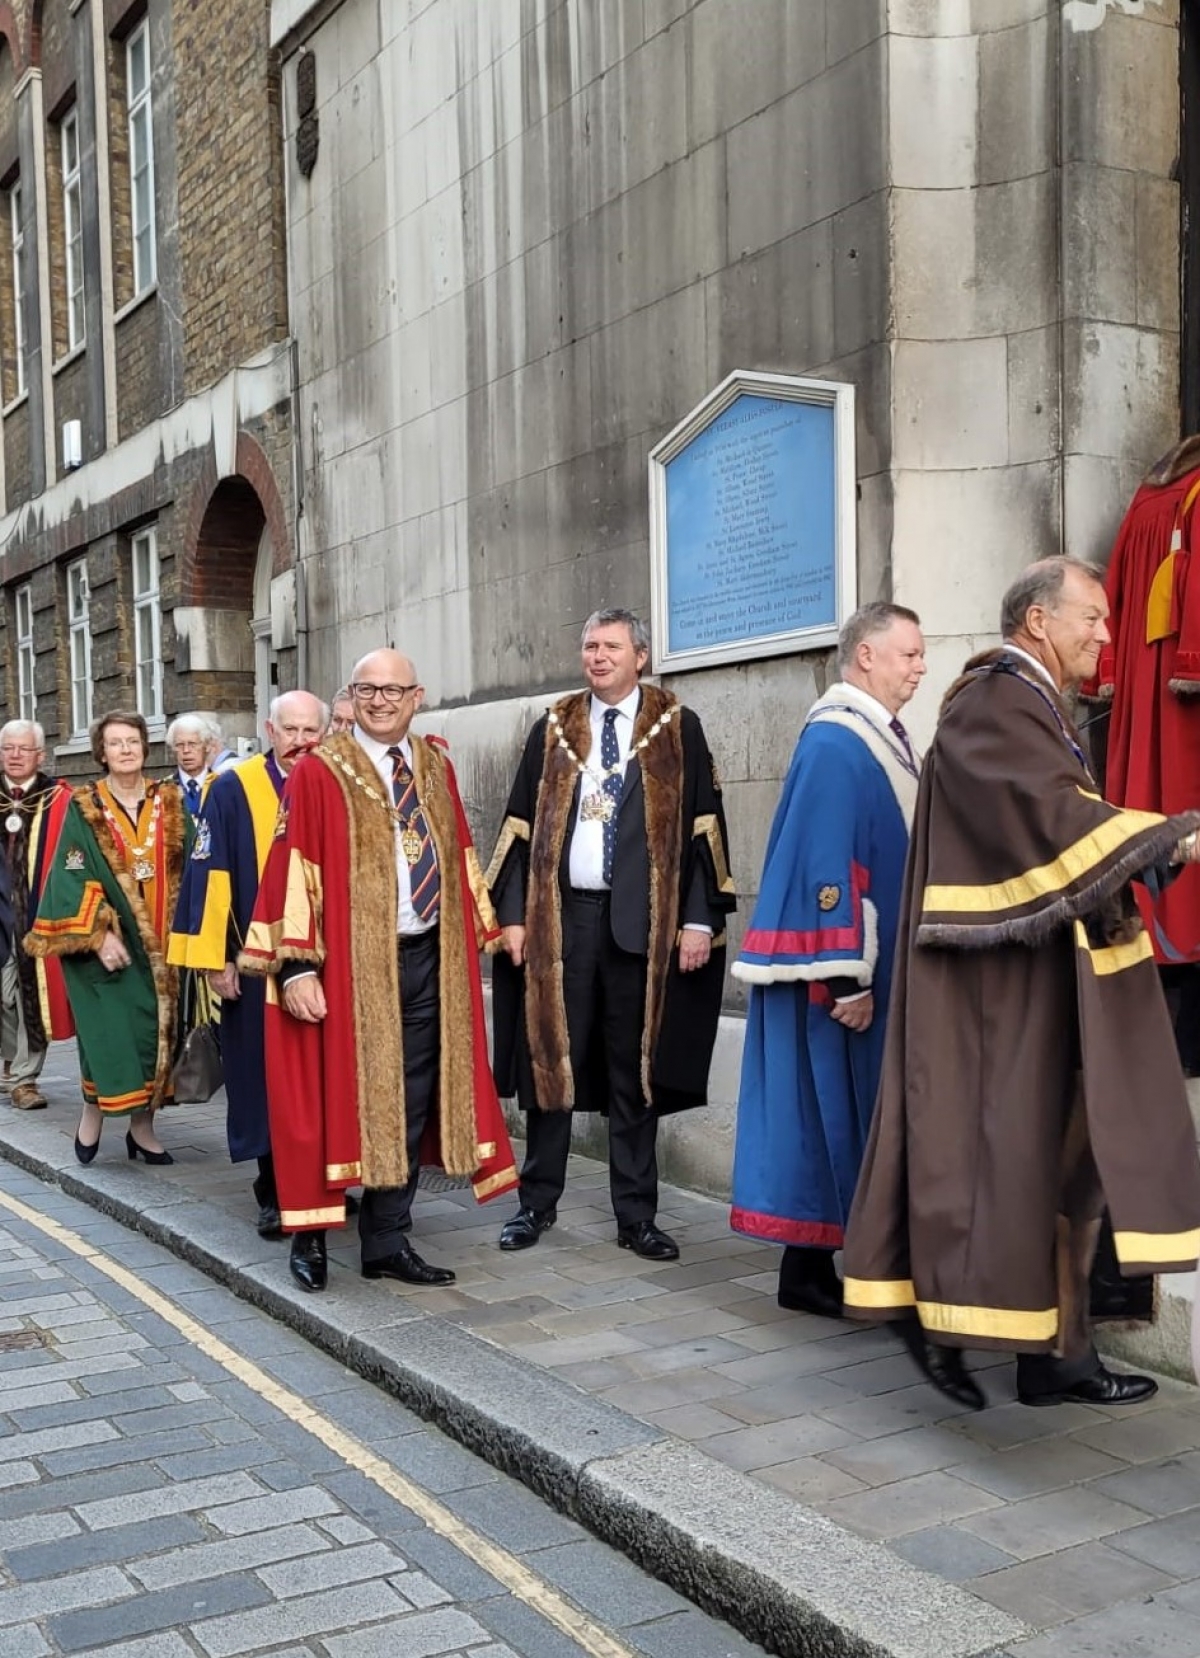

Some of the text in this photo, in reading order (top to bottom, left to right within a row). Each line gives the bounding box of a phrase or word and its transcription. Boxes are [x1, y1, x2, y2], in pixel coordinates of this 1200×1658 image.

[680, 618, 695, 629] Come
[698, 616, 703, 625] in
[706, 613, 717, 624] and
[736, 607, 746, 618] the
[749, 602, 770, 615] Church
[774, 599, 786, 610] and
[704, 627, 713, 637] the
[716, 623, 732, 638] peace
[735, 621, 745, 631] and
[749, 615, 776, 632] presence
[778, 613, 785, 623] of
[787, 610, 801, 621] God
